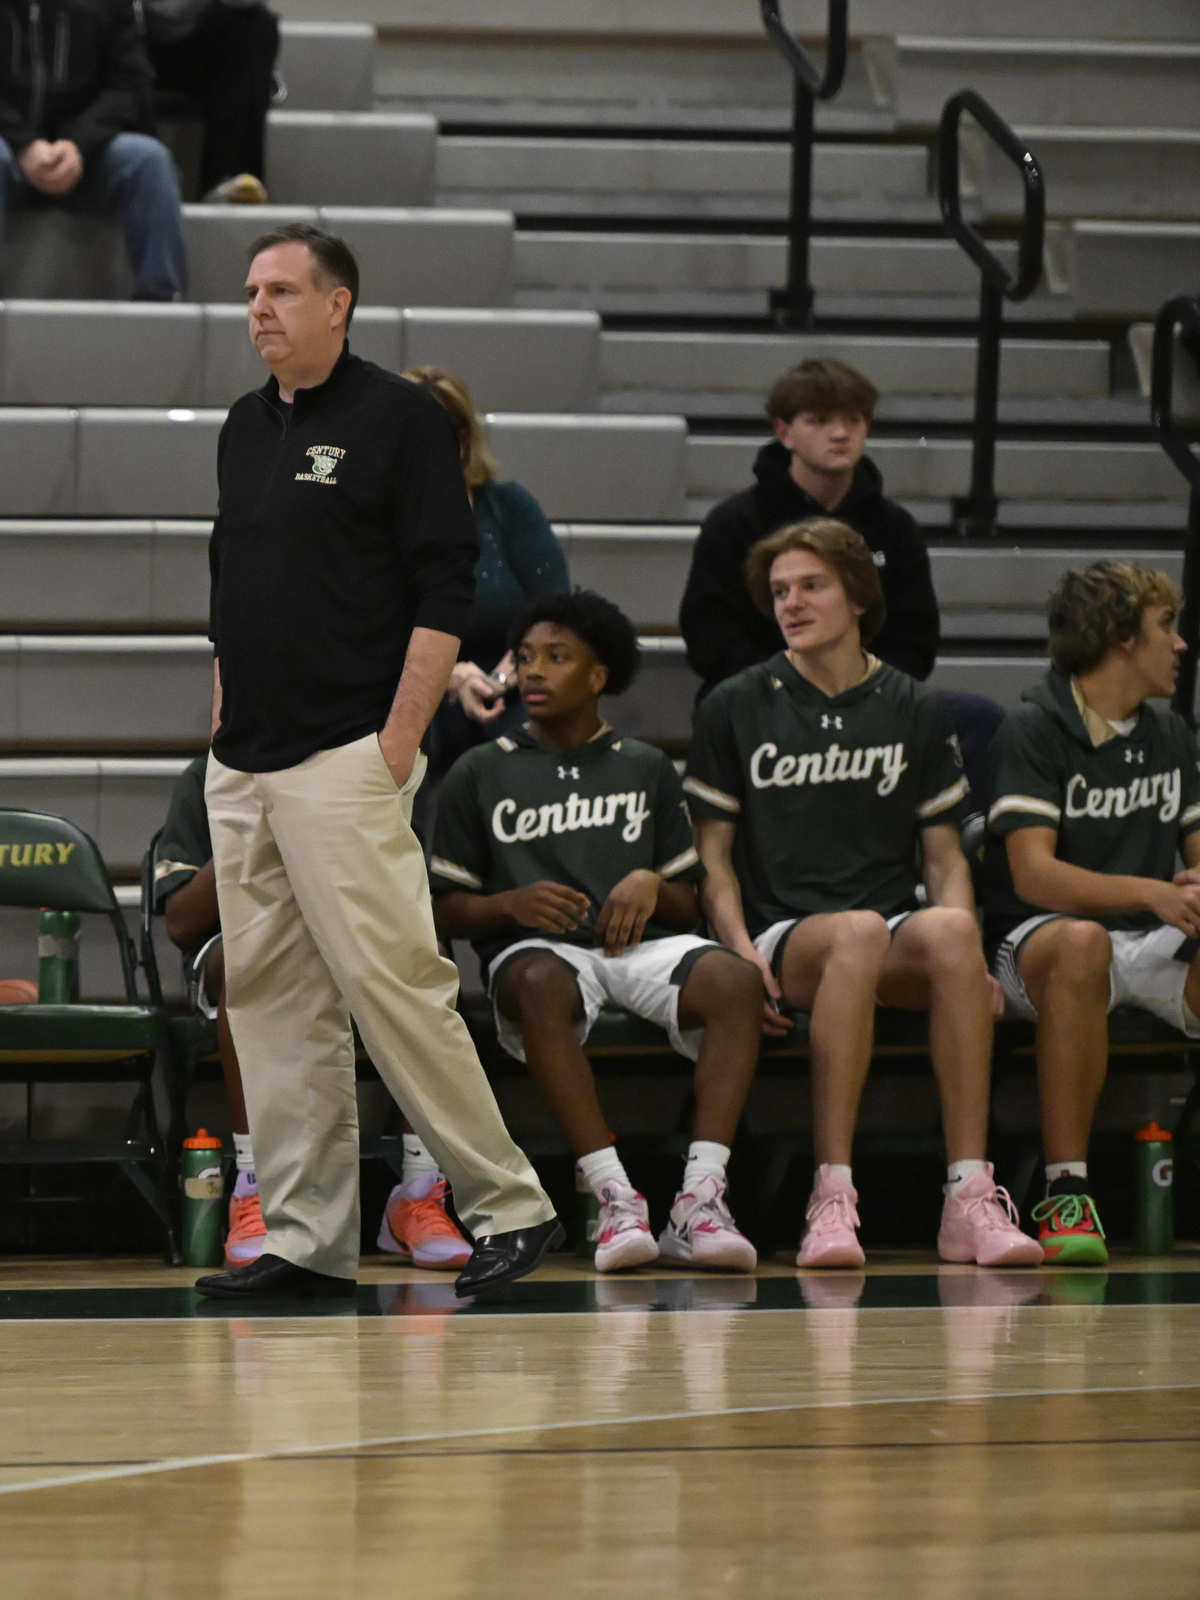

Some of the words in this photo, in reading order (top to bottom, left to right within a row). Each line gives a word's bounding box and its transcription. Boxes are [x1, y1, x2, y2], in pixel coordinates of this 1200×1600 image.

[294, 472, 337, 484] BASKETBALL
[305, 445, 346, 459] CENTURY
[751, 742, 908, 797] Century
[1066, 767, 1181, 823] Century
[492, 791, 650, 843] Century
